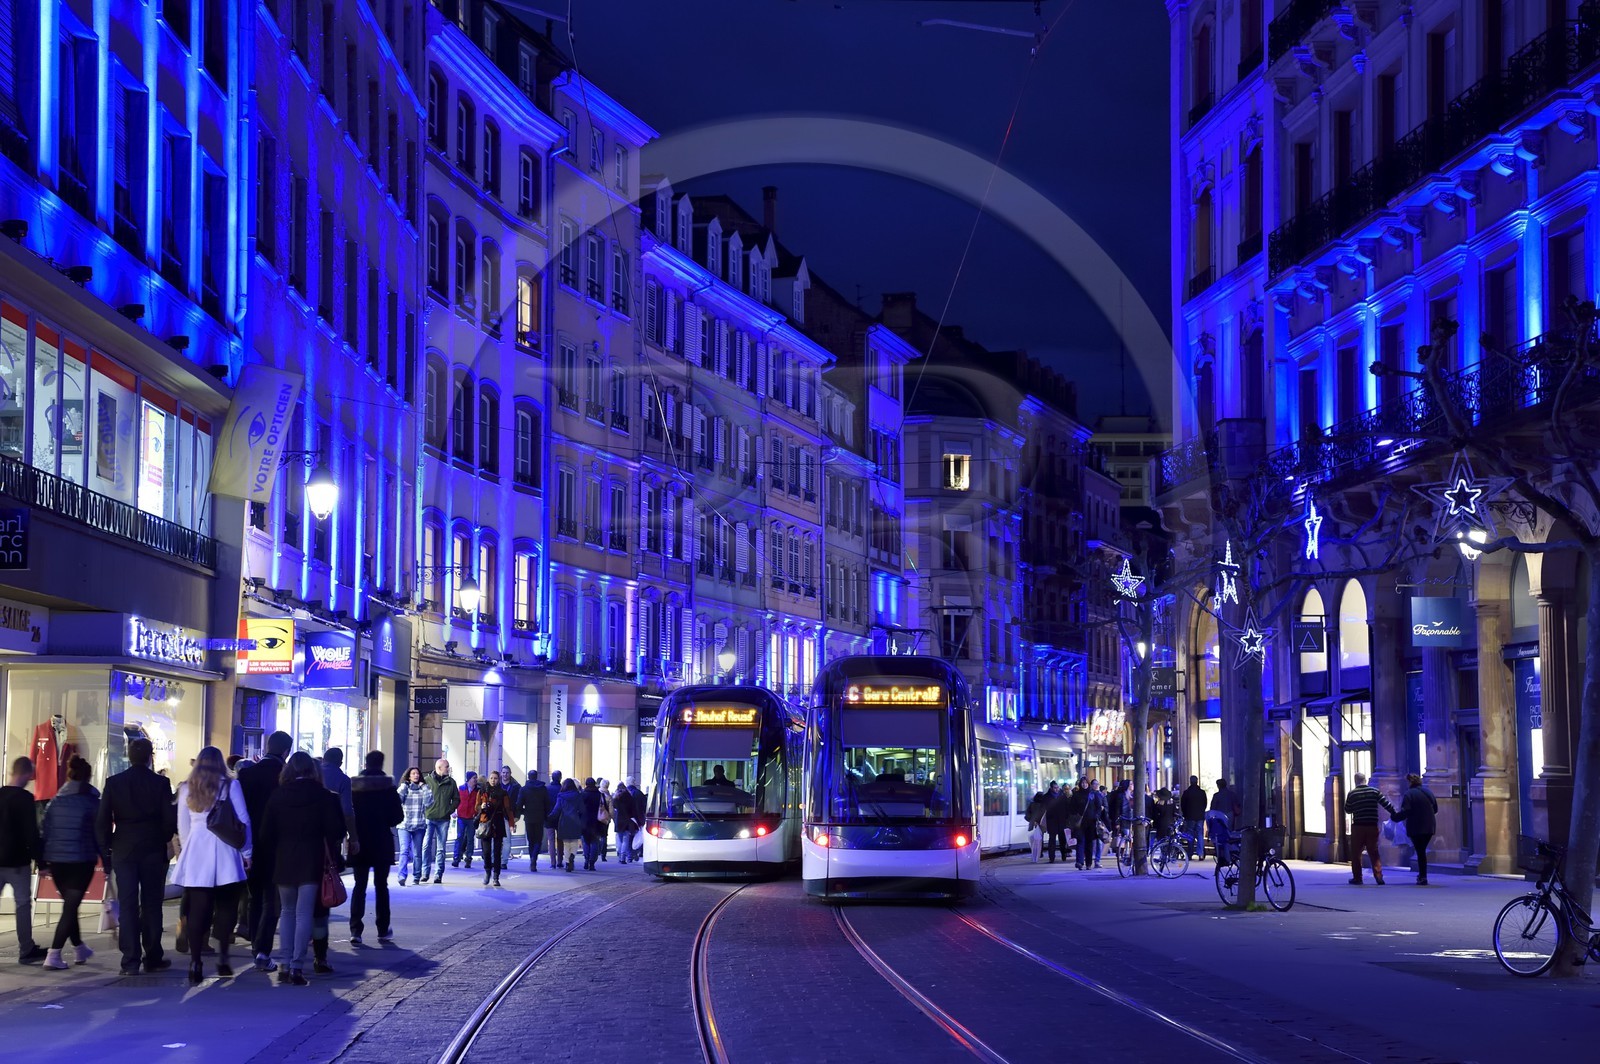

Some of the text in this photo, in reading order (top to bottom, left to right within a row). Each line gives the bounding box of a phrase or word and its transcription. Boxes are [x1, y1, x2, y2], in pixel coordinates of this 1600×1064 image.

[253, 383, 293, 493] VOTRE OPTICIEN
[1413, 624, 1461, 637] Façonnable
[310, 645, 351, 662] WOLF
[416, 695, 446, 704] ba&sh
[849, 686, 859, 701] C
[864, 686, 890, 701] Gare
[683, 709, 693, 722] C
[1530, 715, 1543, 729] STO
